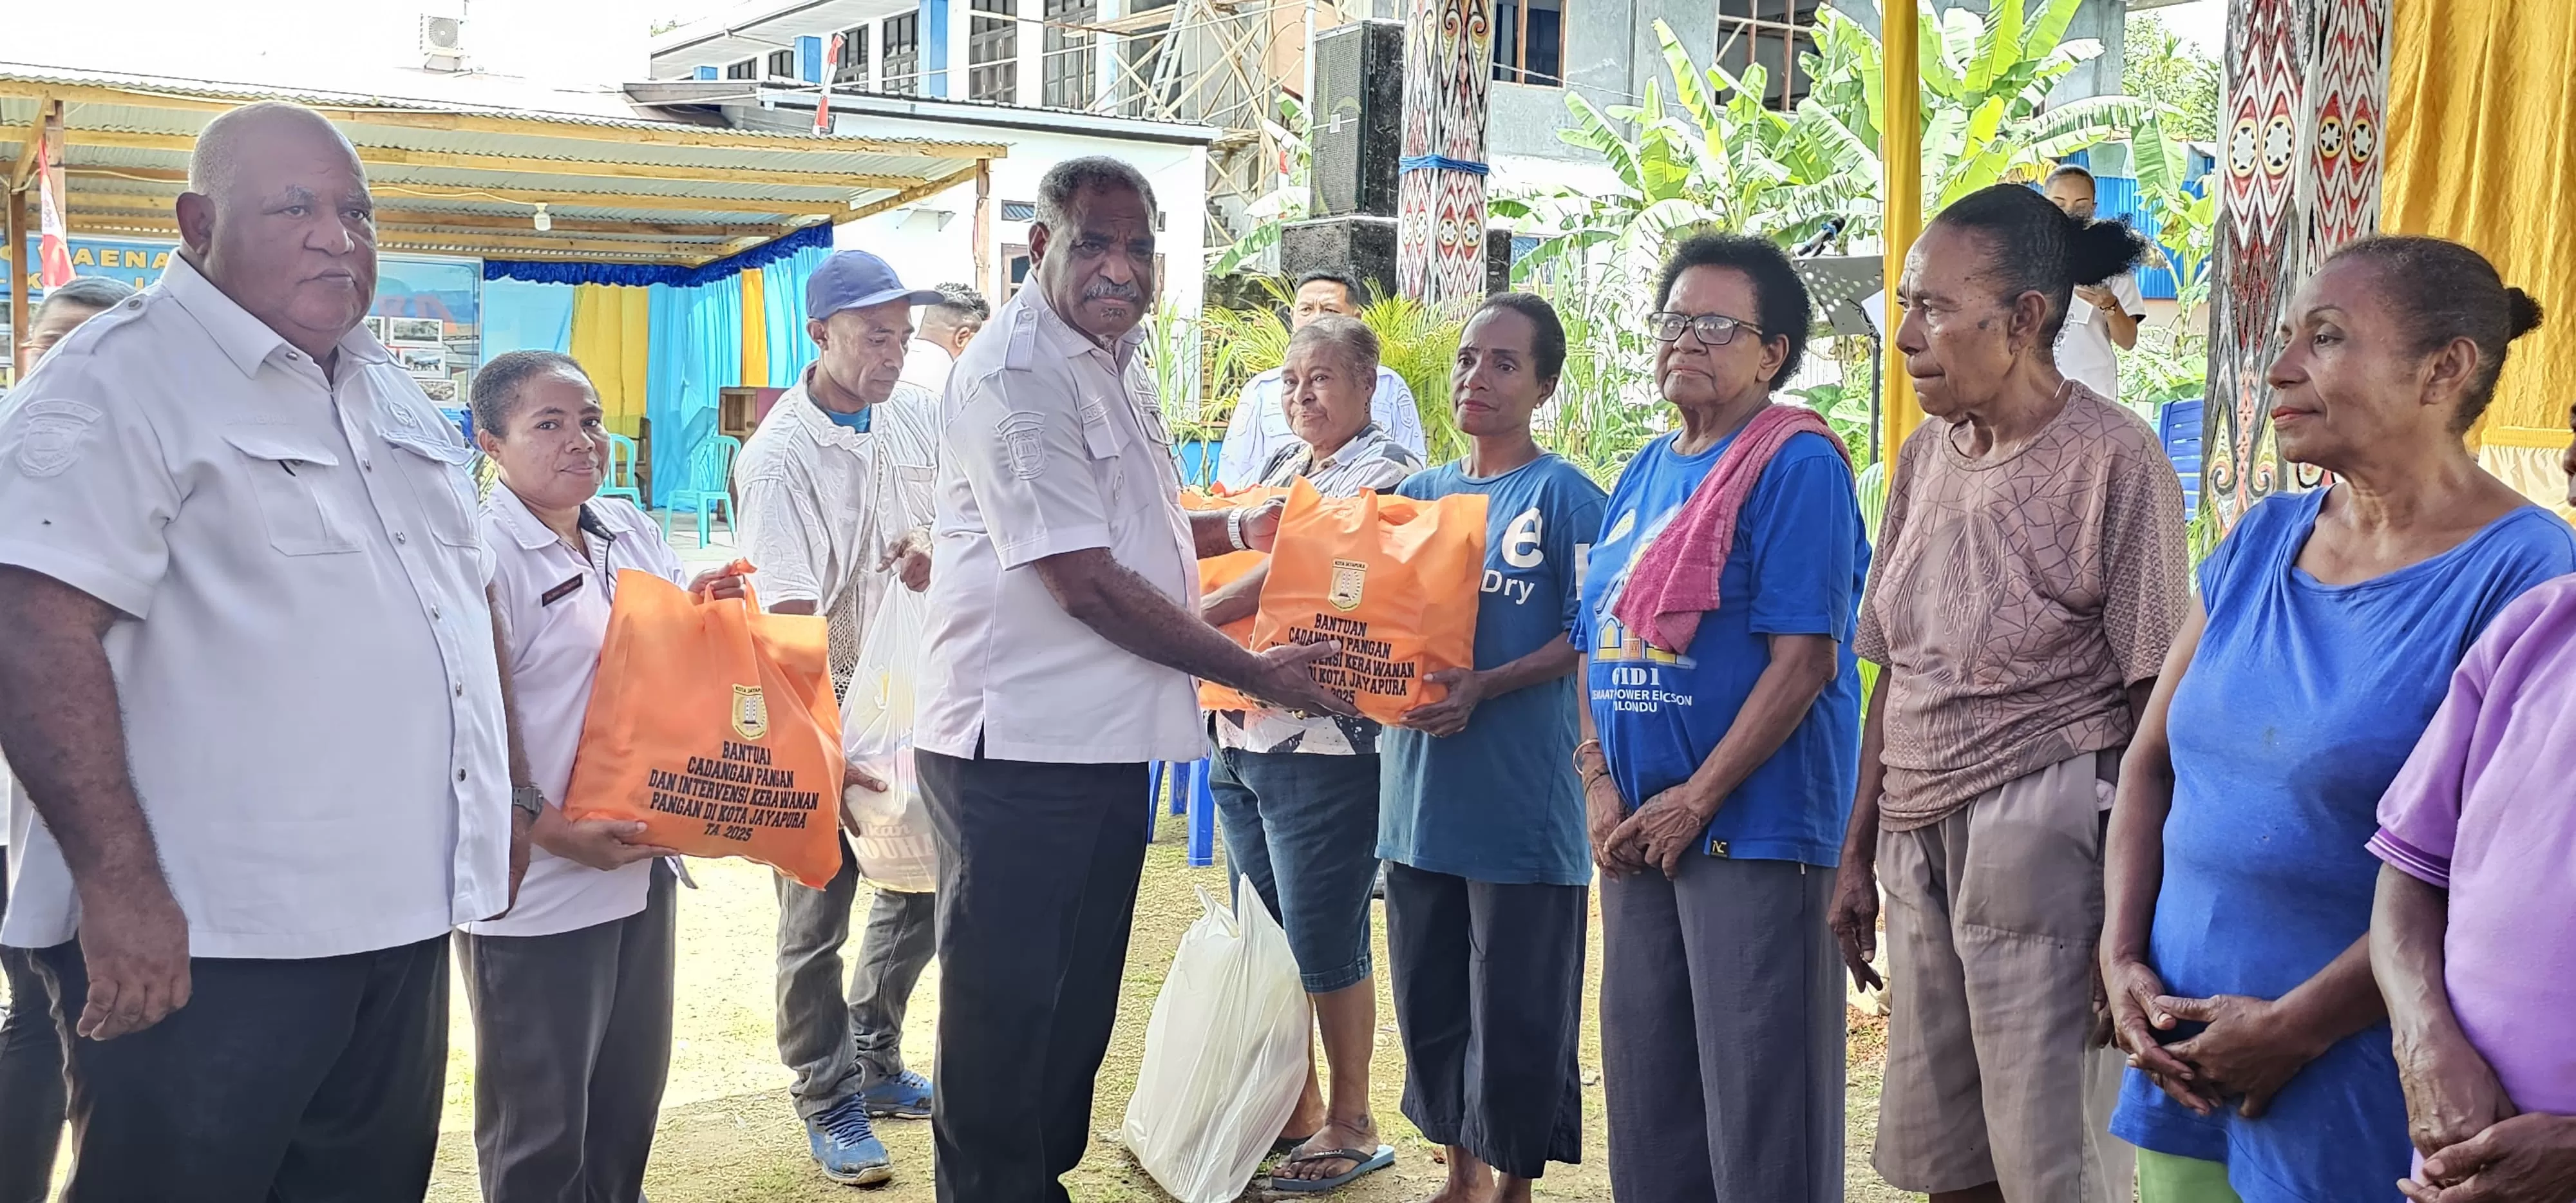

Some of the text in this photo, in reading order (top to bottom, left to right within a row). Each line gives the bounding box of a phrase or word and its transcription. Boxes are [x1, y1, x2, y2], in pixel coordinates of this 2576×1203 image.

[69, 247, 169, 269] AENA
[1481, 569, 1535, 605] Dry
[1314, 613, 1367, 637] BANTUAN
[1346, 637, 1392, 659] PANGAN
[1345, 652, 1415, 678] KERAWANAN
[1319, 667, 1346, 687] KOTA
[1349, 672, 1407, 696] JAYAPURA
[1615, 689, 1649, 701] OWER
[687, 756, 754, 784] CADANGAN
[648, 769, 819, 810] DAN INTERVENSI KERAWANAN
[650, 791, 808, 829] PANGAN DI KOTA JAYAPURA
[722, 825, 753, 842] 2025
